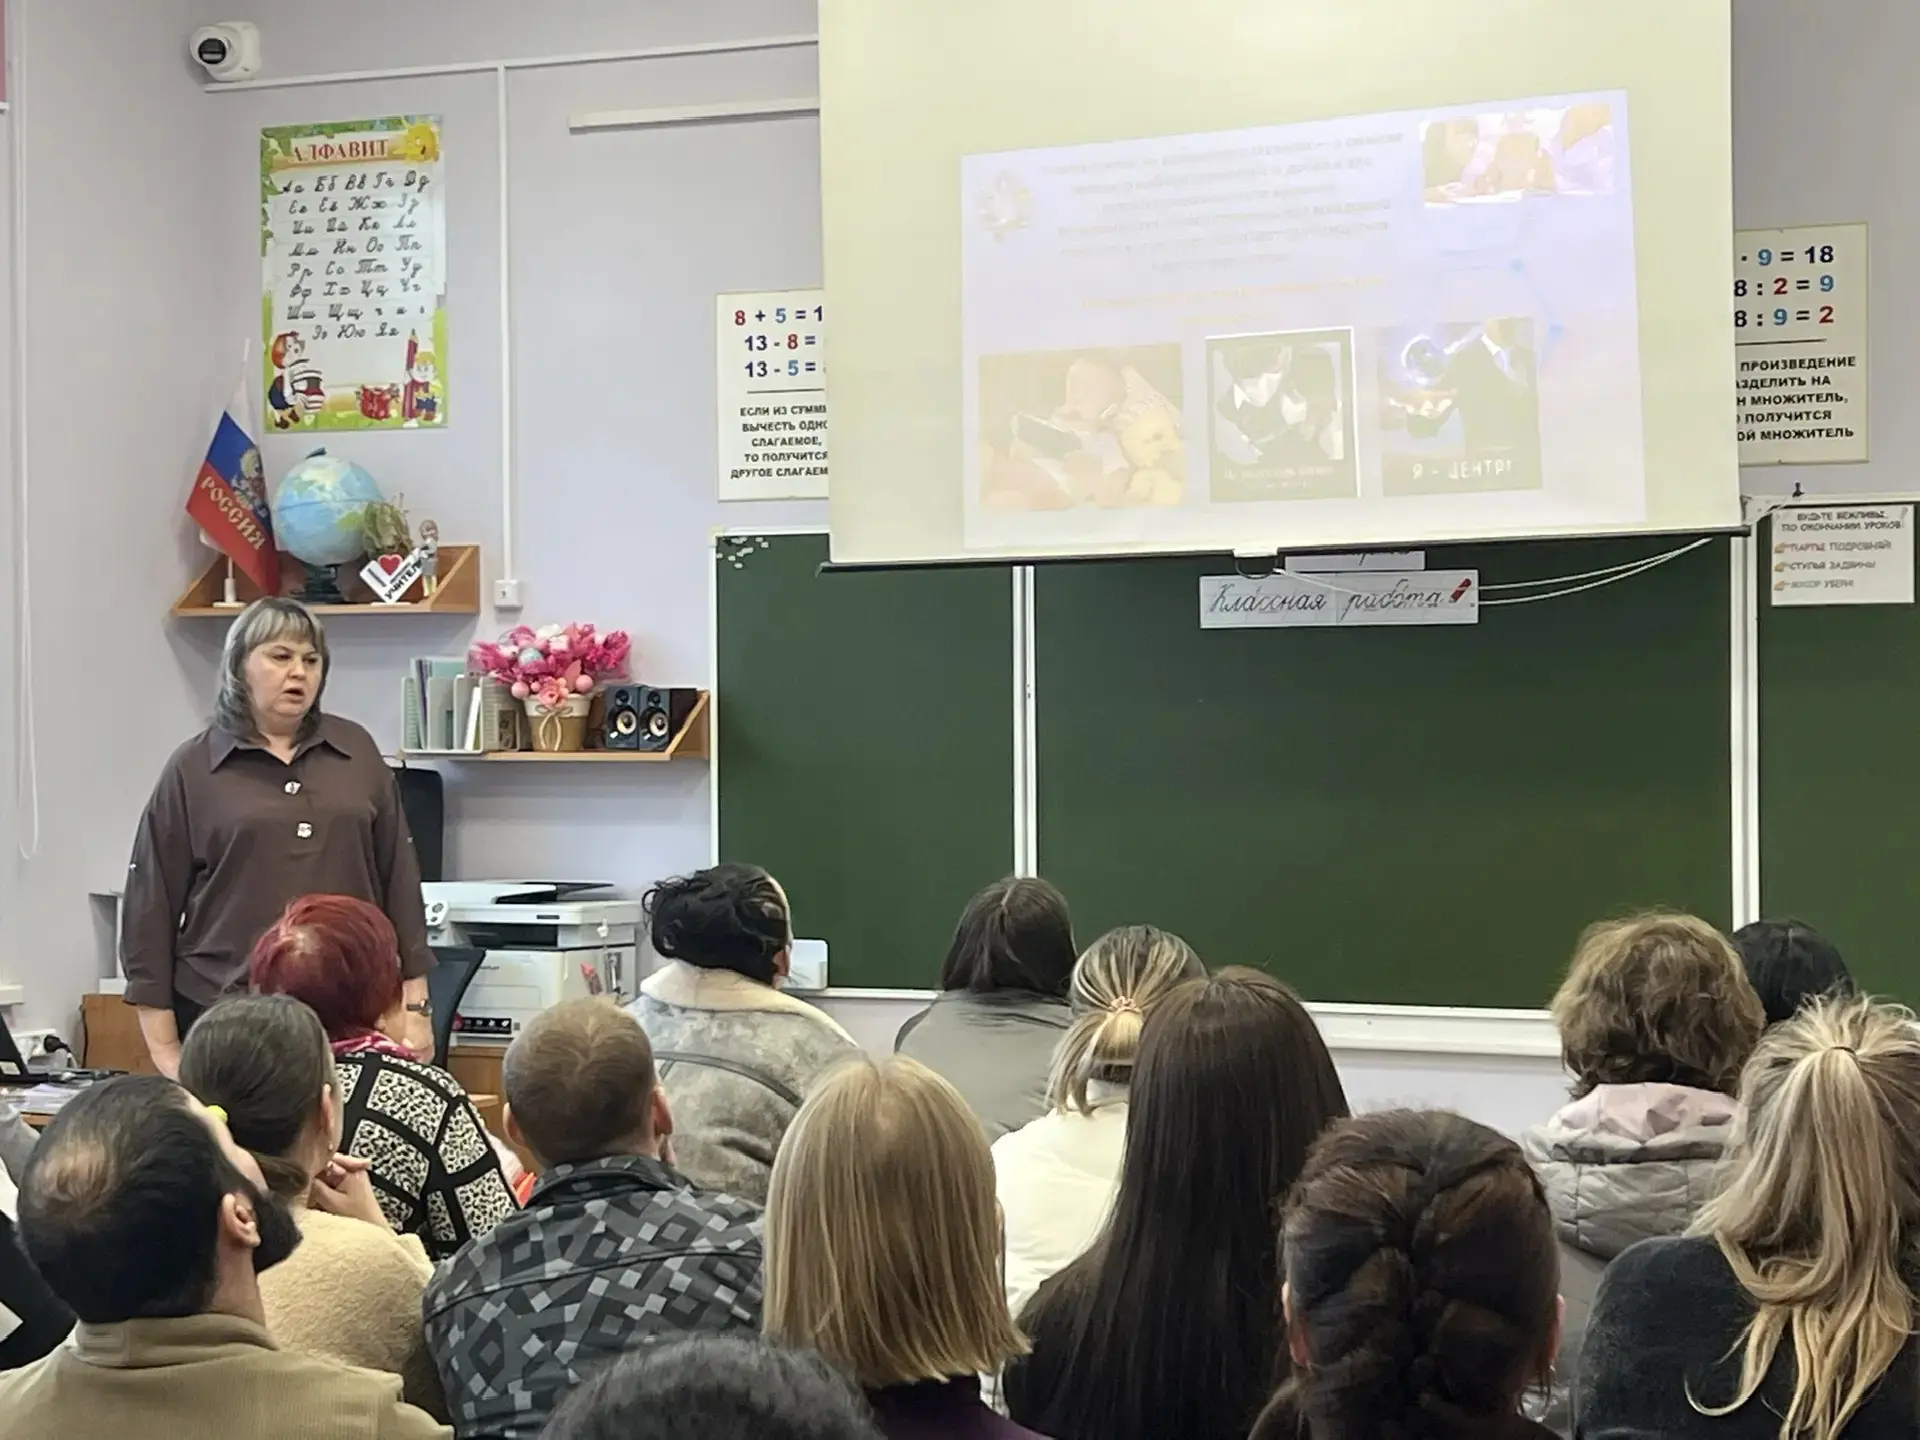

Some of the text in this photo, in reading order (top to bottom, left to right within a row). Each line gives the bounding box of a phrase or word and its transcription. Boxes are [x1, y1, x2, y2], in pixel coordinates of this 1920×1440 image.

[293, 139, 388, 161] АЛФАВИТ
[314, 174, 338, 192] Бб
[345, 173, 367, 190] Вв
[403, 170, 430, 193] Дд
[348, 195, 387, 211] Жж
[359, 216, 380, 231] Кк
[333, 238, 357, 254] Нн
[366, 236, 384, 253] Оо
[395, 234, 422, 250] Пп
[1758, 248, 1772, 265] 9
[1804, 245, 1834, 264] 18
[287, 262, 313, 284] Рр
[355, 258, 388, 273] Тт
[400, 256, 423, 278] Уу
[323, 281, 352, 296] Хх
[360, 279, 389, 298] Цц
[1734, 279, 1747, 297] 8
[1773, 277, 1788, 295] 2
[1819, 274, 1834, 292] 9
[287, 305, 316, 320] Шш
[328, 303, 364, 321] Щщ
[734, 310, 746, 326] 8
[775, 307, 787, 323] 5
[813, 306, 823, 322] 1
[1734, 310, 1747, 328] 8
[1773, 308, 1787, 326] 9
[1819, 305, 1834, 323] 2
[337, 323, 367, 339] Юю
[375, 322, 400, 337] Яя
[744, 335, 768, 352] 13
[787, 333, 798, 350] 8
[744, 361, 768, 378] 13
[787, 359, 799, 376] 5
[1740, 356, 1856, 372] ПРОИЗВЕДЕНИЕ
[1736, 375, 1831, 391] ЗДЕЛИТЬ НА
[1751, 392, 1848, 406] МНОЖИТЕЛЬ,
[740, 406, 769, 417] ЕСЛИ
[773, 405, 788, 416] ИЗ
[1745, 410, 1832, 424] ПОЛУЧИТСЯ
[742, 421, 796, 432] ВЫЧЕСТЬ
[1760, 428, 1854, 441] МНОЖИТЕЛЬ
[751, 436, 822, 447] СЛАГАЕМОЕ,
[744, 451, 828, 463] ТО ПОЛУЧИТСЯ
[730, 466, 828, 479] ДРУГОЕ СЛАГАЕМ
[200, 476, 265, 550] РОССИЯ
[1210, 578, 1441, 620] Классная работа
